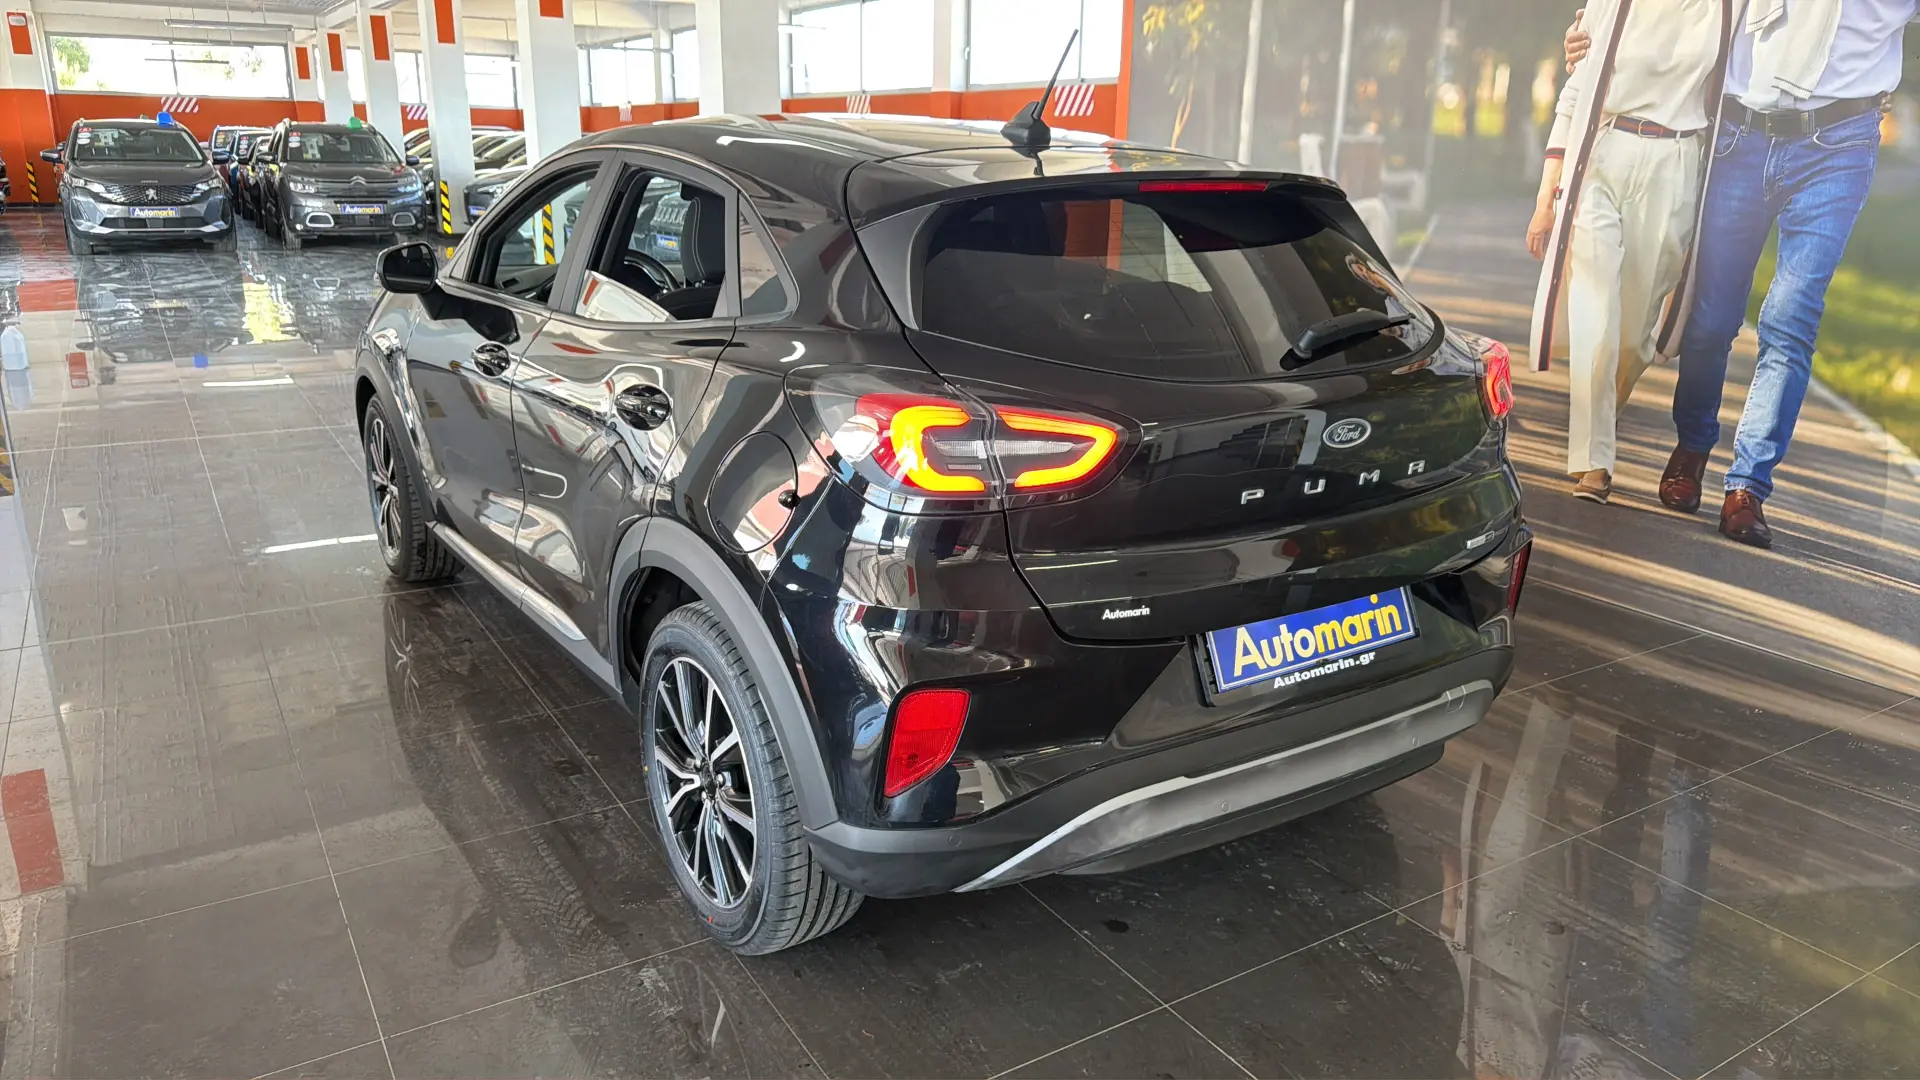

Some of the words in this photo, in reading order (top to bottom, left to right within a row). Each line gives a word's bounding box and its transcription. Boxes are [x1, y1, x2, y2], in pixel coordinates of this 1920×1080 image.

[133, 207, 176, 217] Automarin
[1333, 424, 1361, 443] Ford
[1102, 604, 1150, 620] Automarin
[1233, 593, 1402, 678] Automarin
[1273, 650, 1377, 689] Automarin.gr
